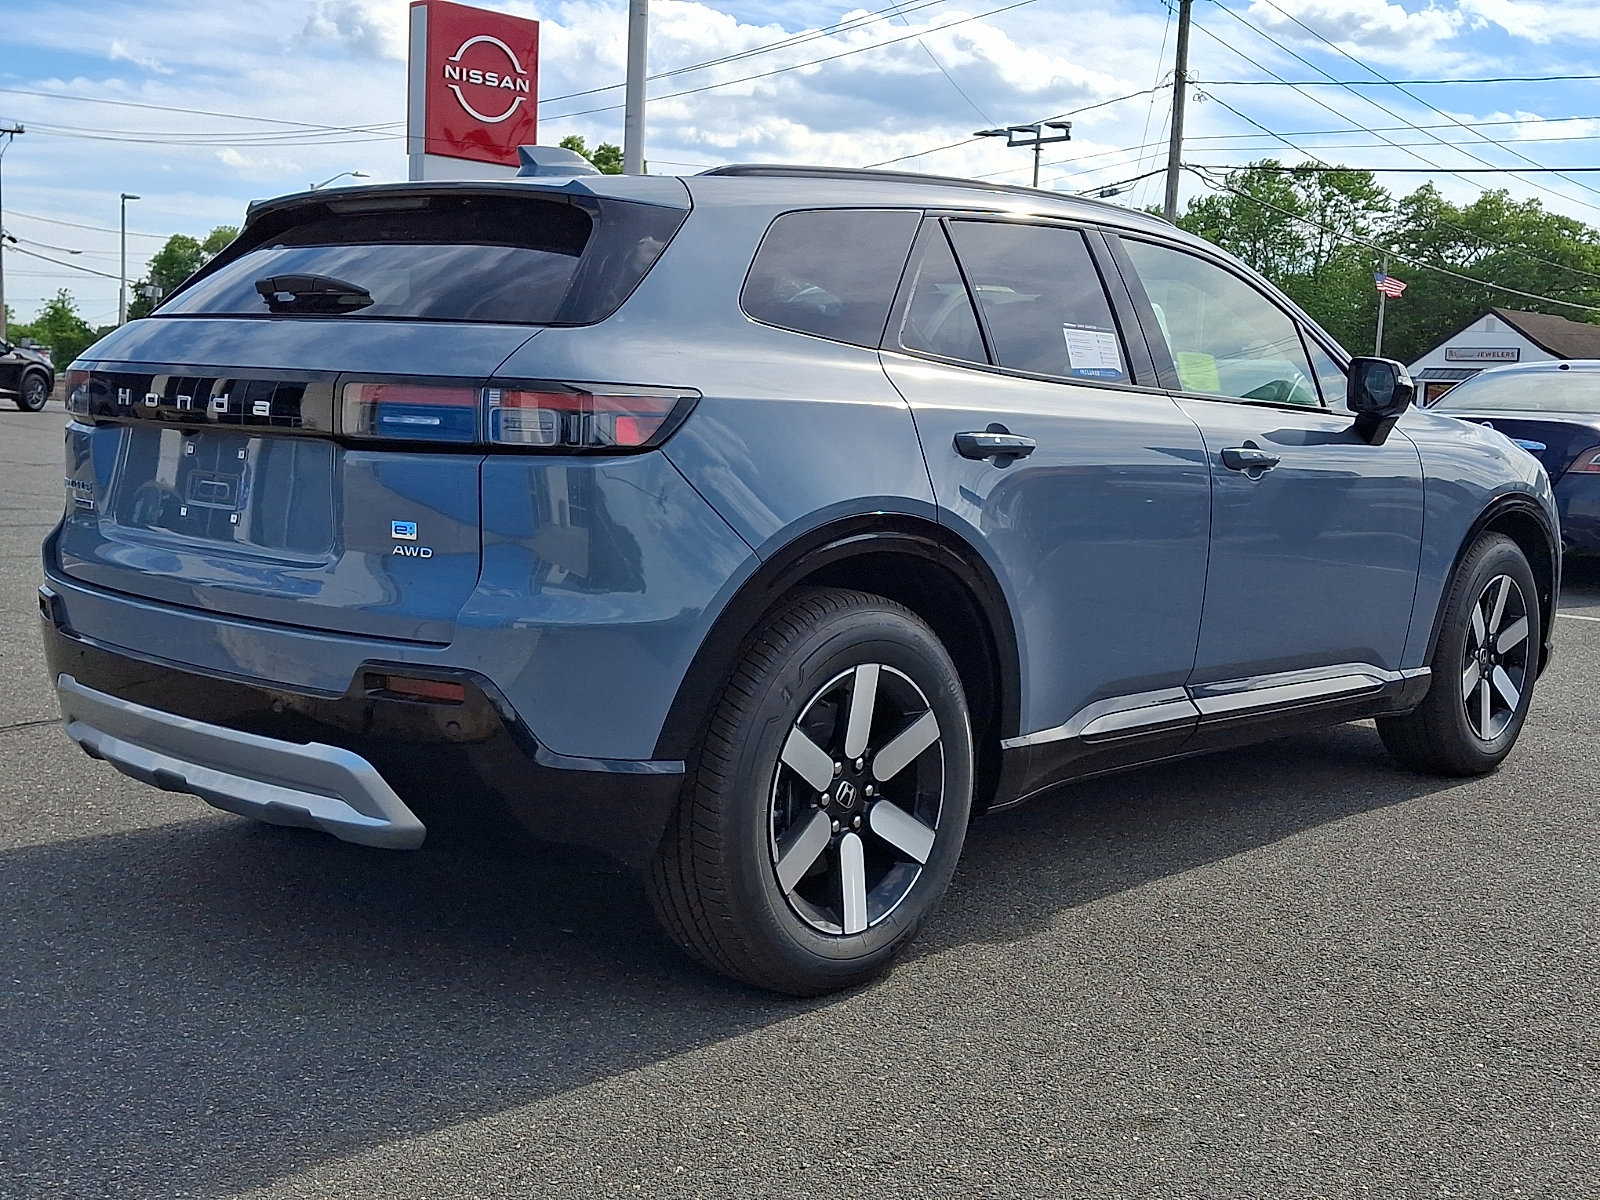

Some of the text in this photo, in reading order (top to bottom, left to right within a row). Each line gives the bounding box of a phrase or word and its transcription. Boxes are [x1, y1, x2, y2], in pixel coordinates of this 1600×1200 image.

[444, 64, 530, 93] NISSAN
[118, 387, 271, 417] Honda
[392, 545, 433, 558] AWD
